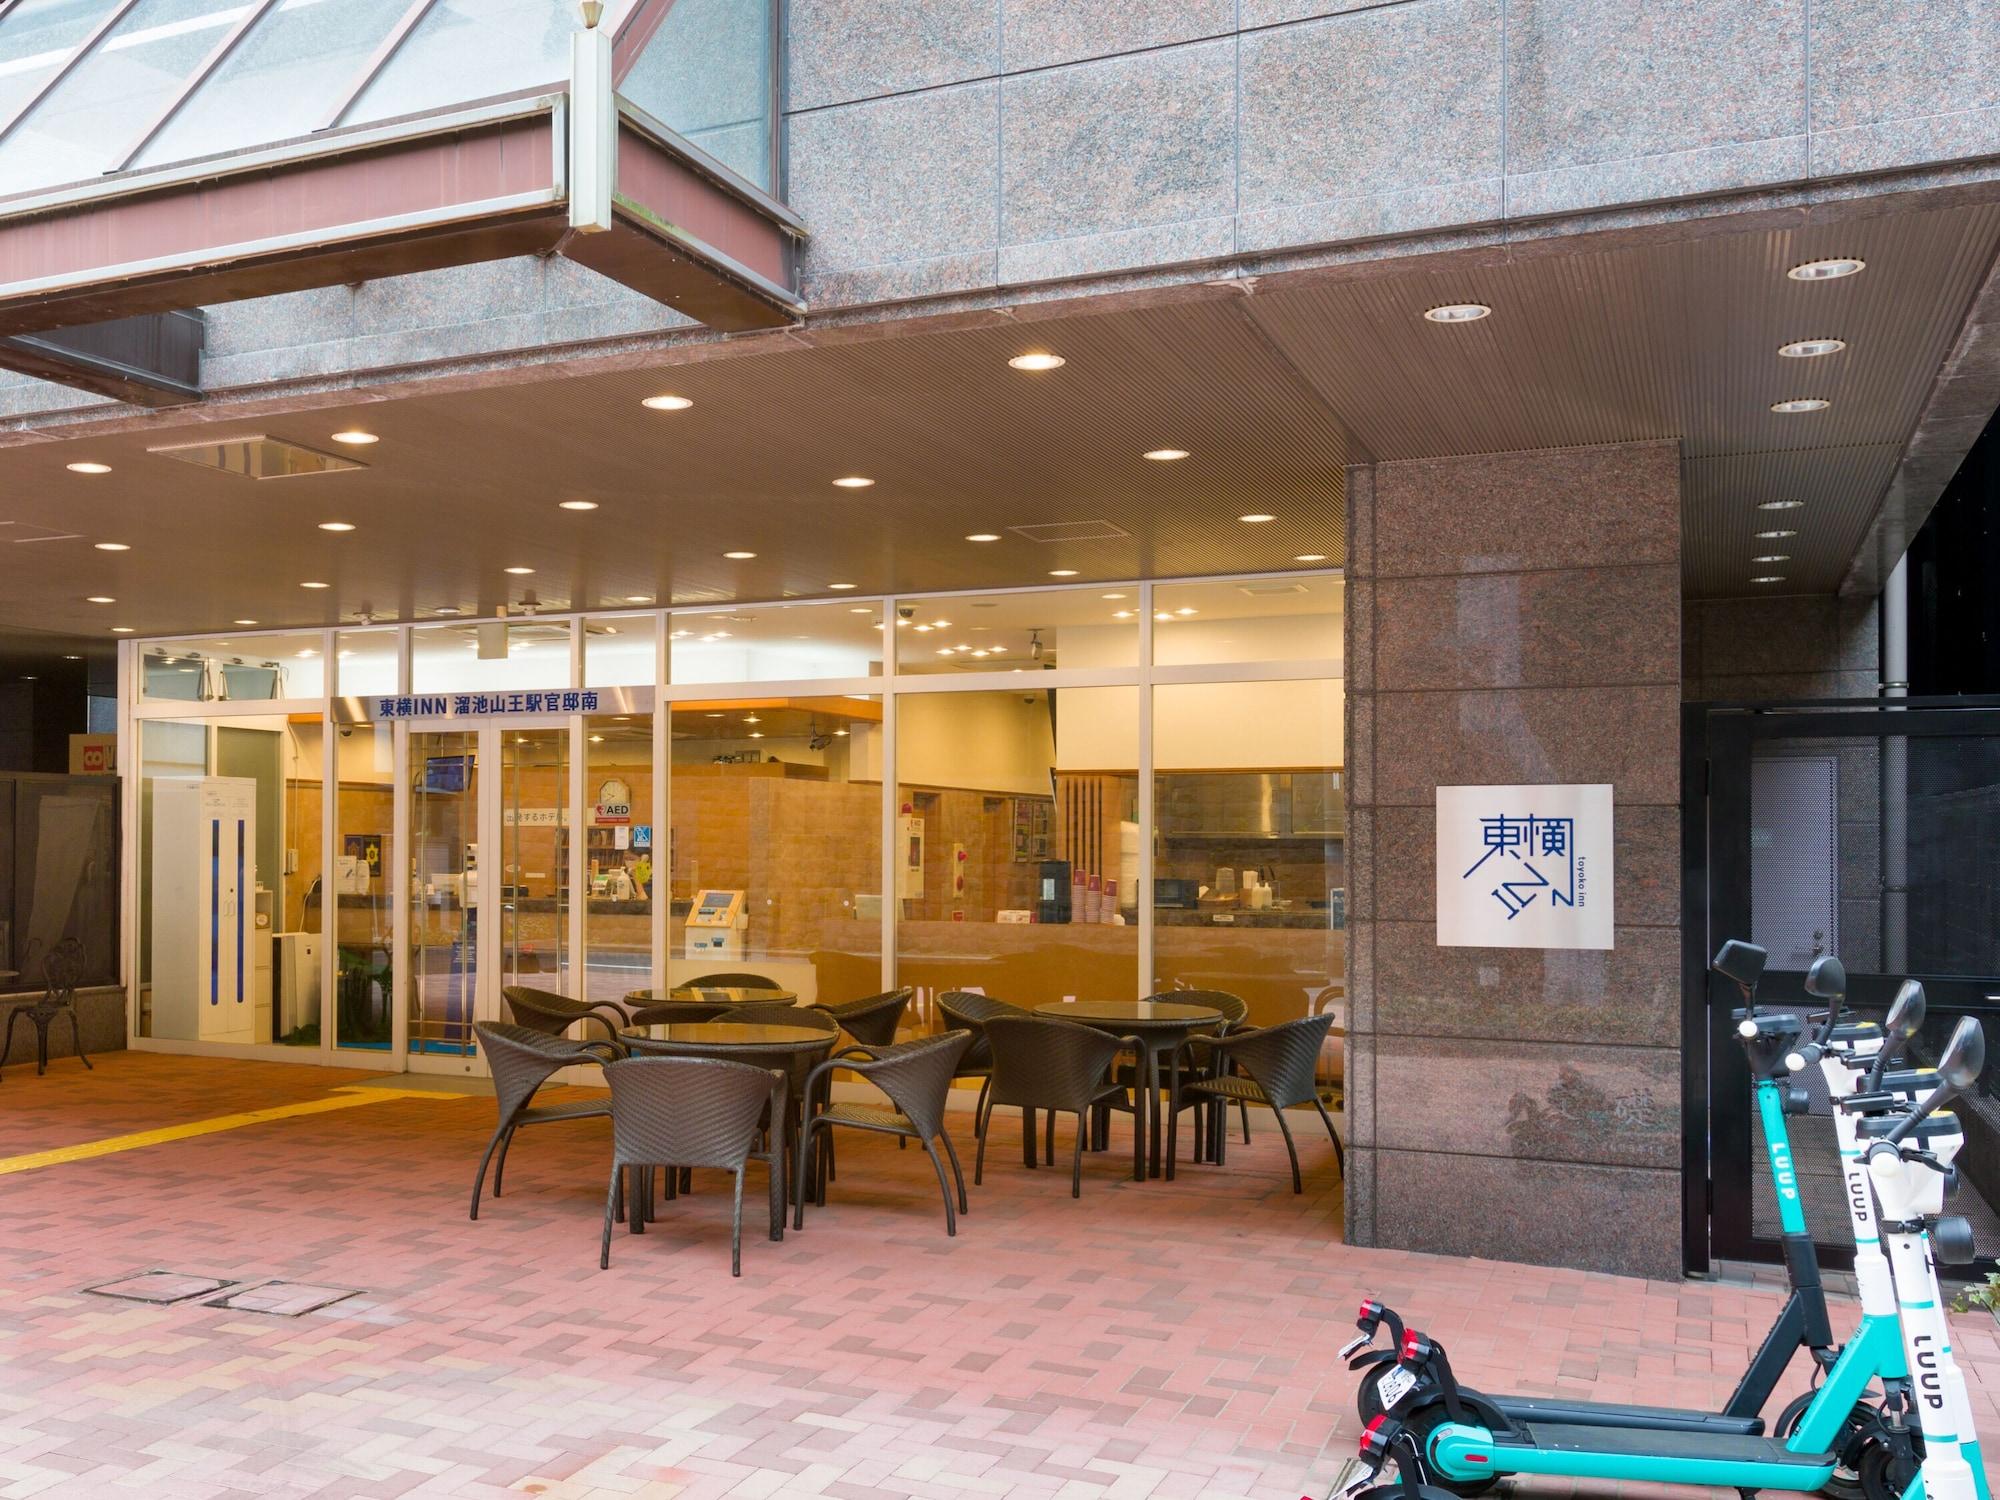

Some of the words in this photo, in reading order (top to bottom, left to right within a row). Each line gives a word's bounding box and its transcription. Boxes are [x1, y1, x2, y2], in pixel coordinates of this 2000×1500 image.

[379, 697, 447, 716] 東横INN
[454, 691, 598, 714] 溜池山王駅官邸南
[606, 805, 629, 815] AED
[1577, 856, 1587, 890] toyoko
[1578, 891, 1587, 907] inn
[1771, 1142, 1796, 1200] LUUP
[1848, 1172, 1868, 1222] LUUP
[1913, 1335, 1944, 1410] LUUP
